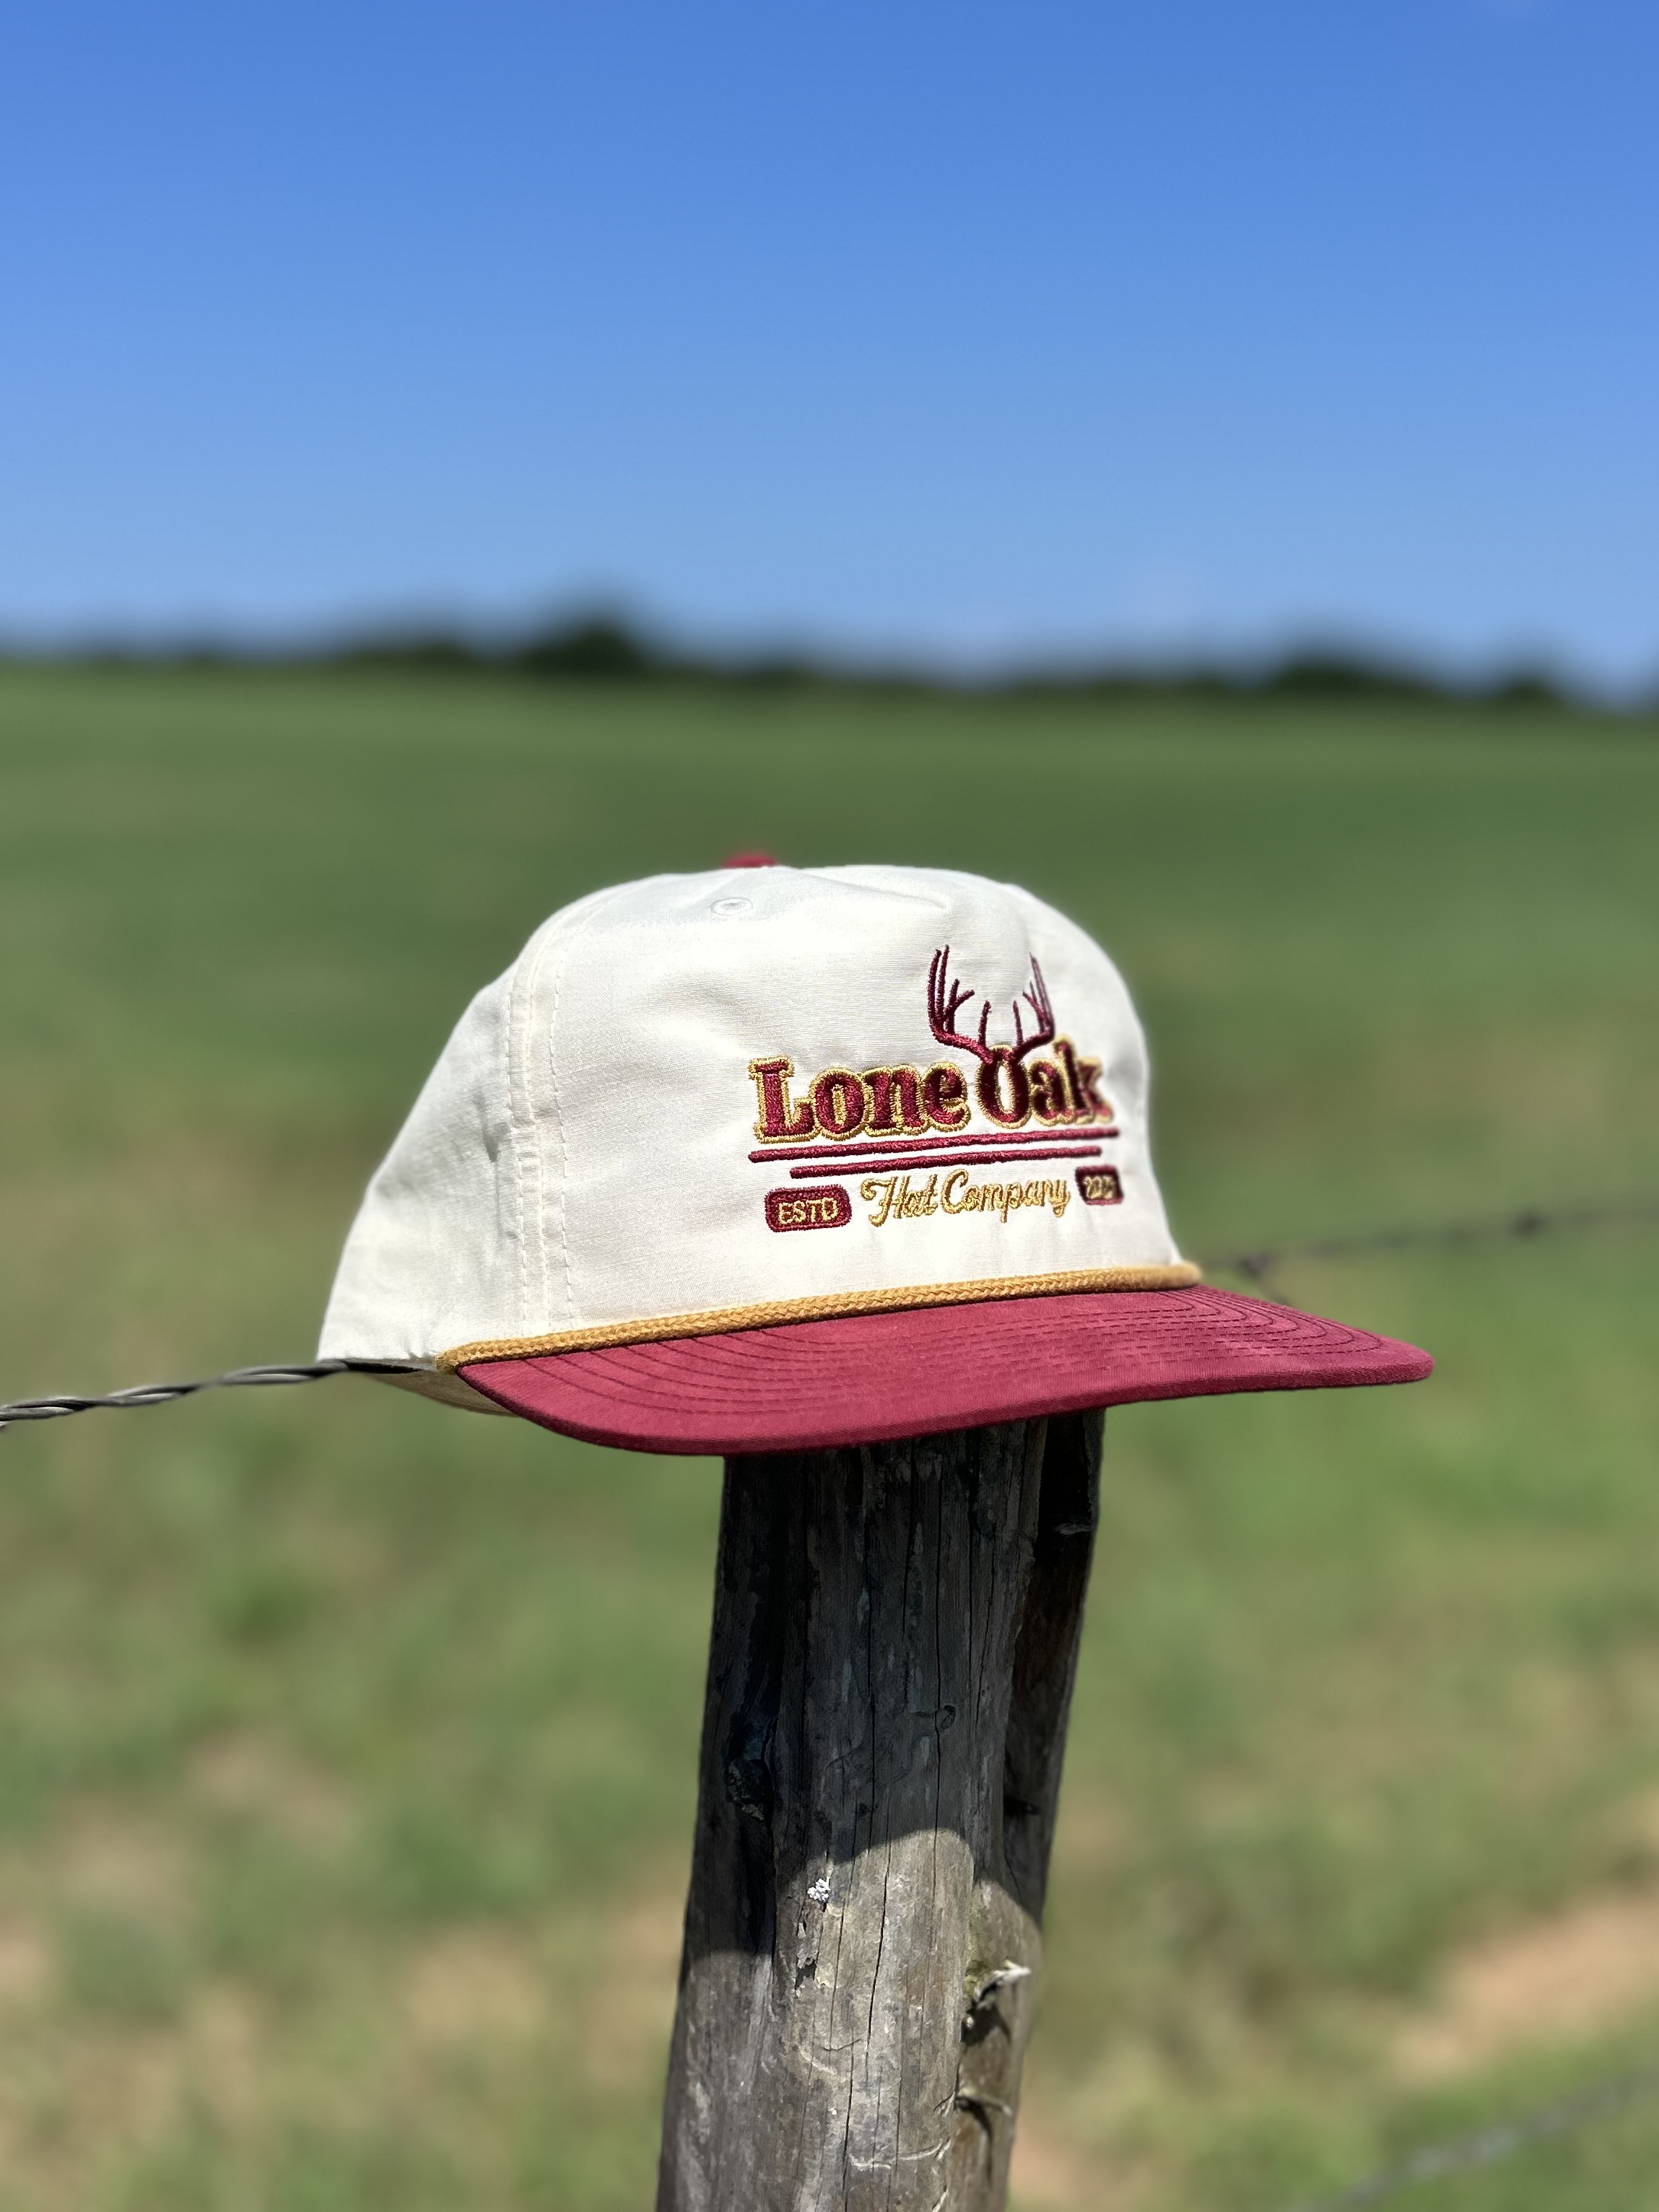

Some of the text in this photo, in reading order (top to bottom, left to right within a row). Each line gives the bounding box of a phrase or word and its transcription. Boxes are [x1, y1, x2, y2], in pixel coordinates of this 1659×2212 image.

[749, 1035, 1113, 1144] Lone Oak
[778, 1198, 838, 1225] ESTD
[860, 1169, 1071, 1227] Hat Company
